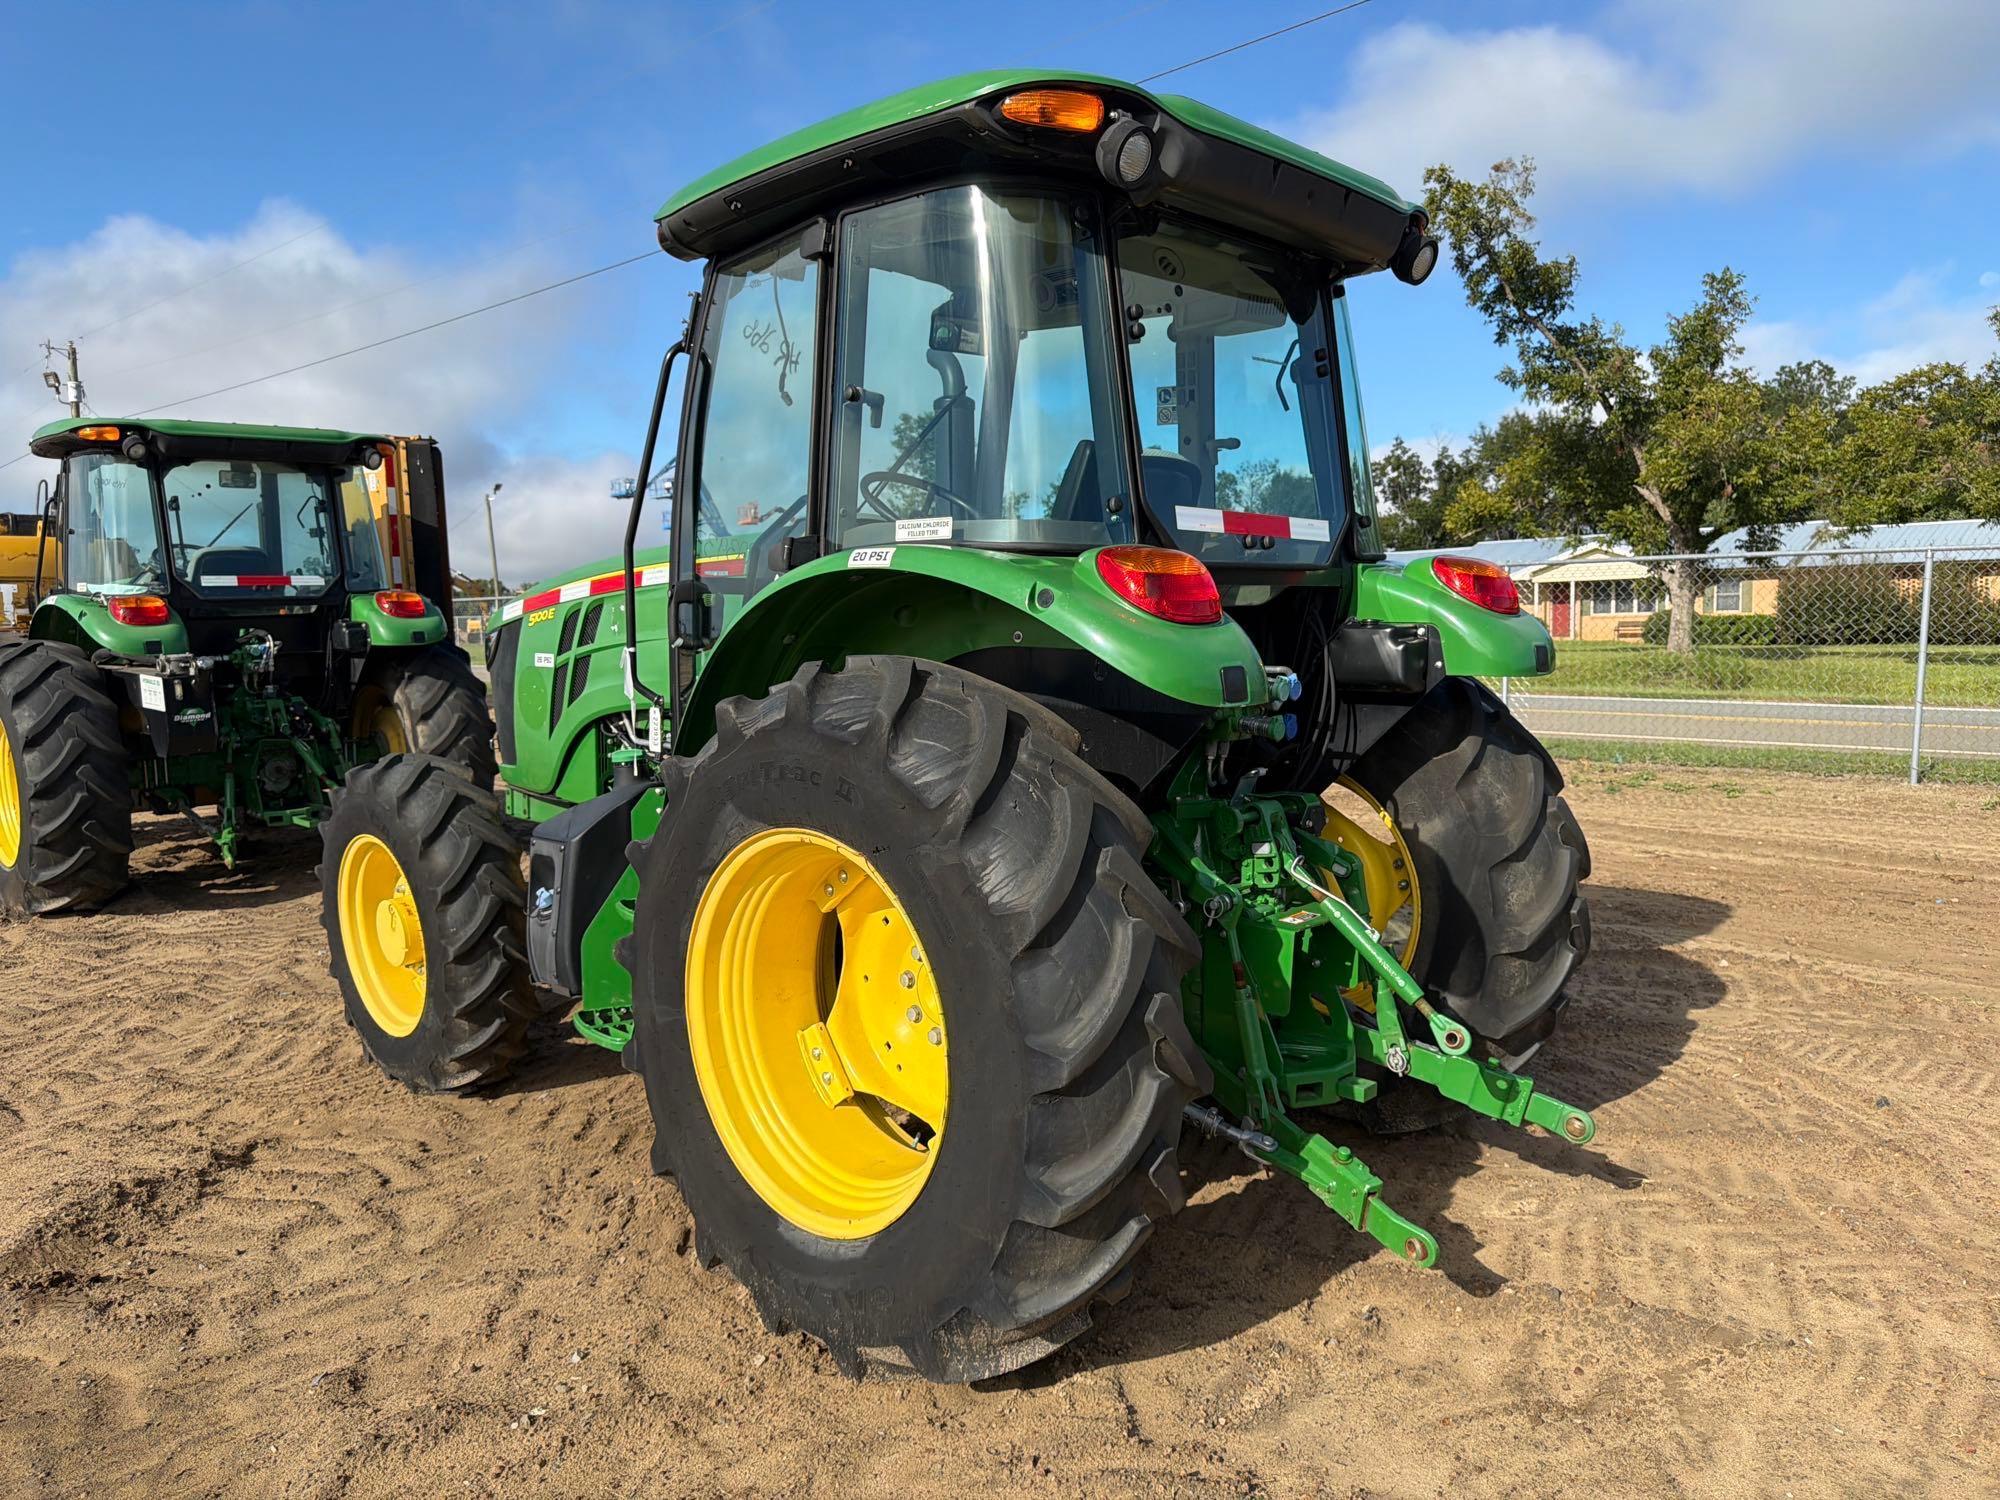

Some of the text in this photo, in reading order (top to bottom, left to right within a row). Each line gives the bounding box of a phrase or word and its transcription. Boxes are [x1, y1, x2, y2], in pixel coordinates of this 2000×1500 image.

[898, 521, 949, 530] CALCIUM CHLORIDE
[907, 529, 925, 537] FILLED
[852, 552, 890, 562] 20 PSI
[173, 711, 212, 722] Diamond
